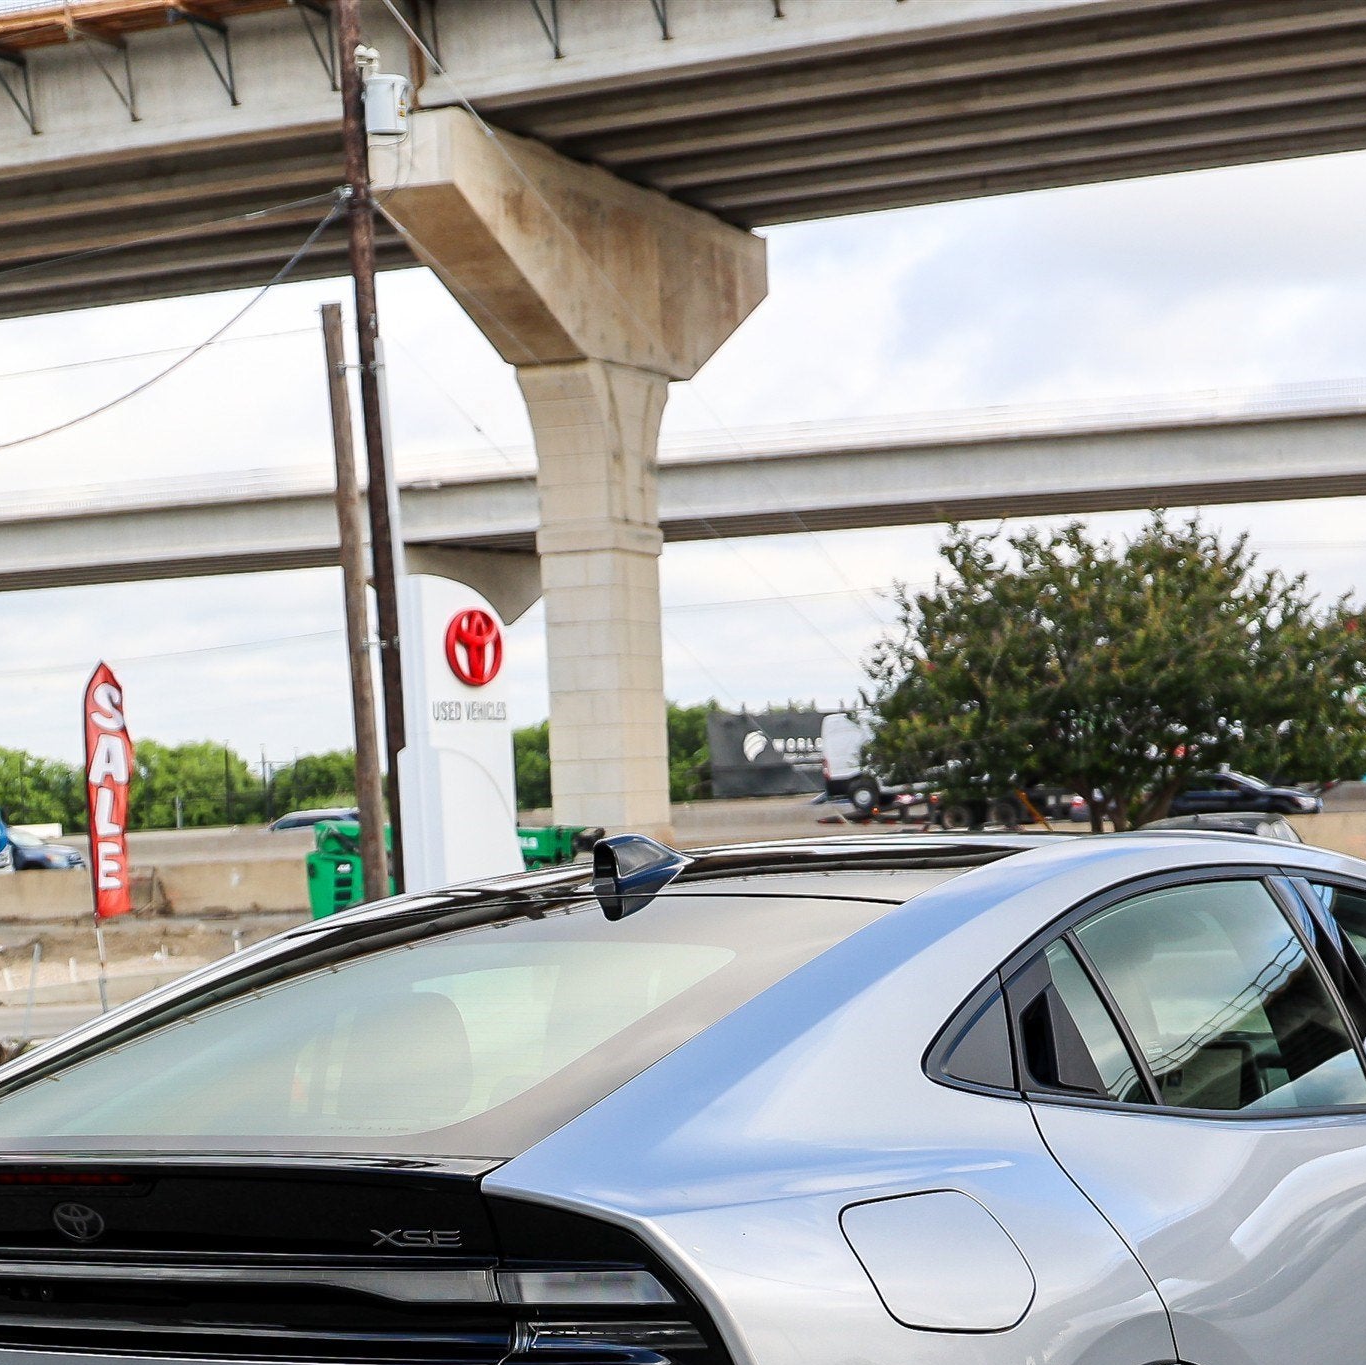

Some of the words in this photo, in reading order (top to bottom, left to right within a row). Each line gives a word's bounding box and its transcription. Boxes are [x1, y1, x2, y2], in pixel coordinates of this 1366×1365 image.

[432, 701, 461, 720] USED
[90, 681, 129, 890] SALE
[370, 1229, 462, 1247] XSE
